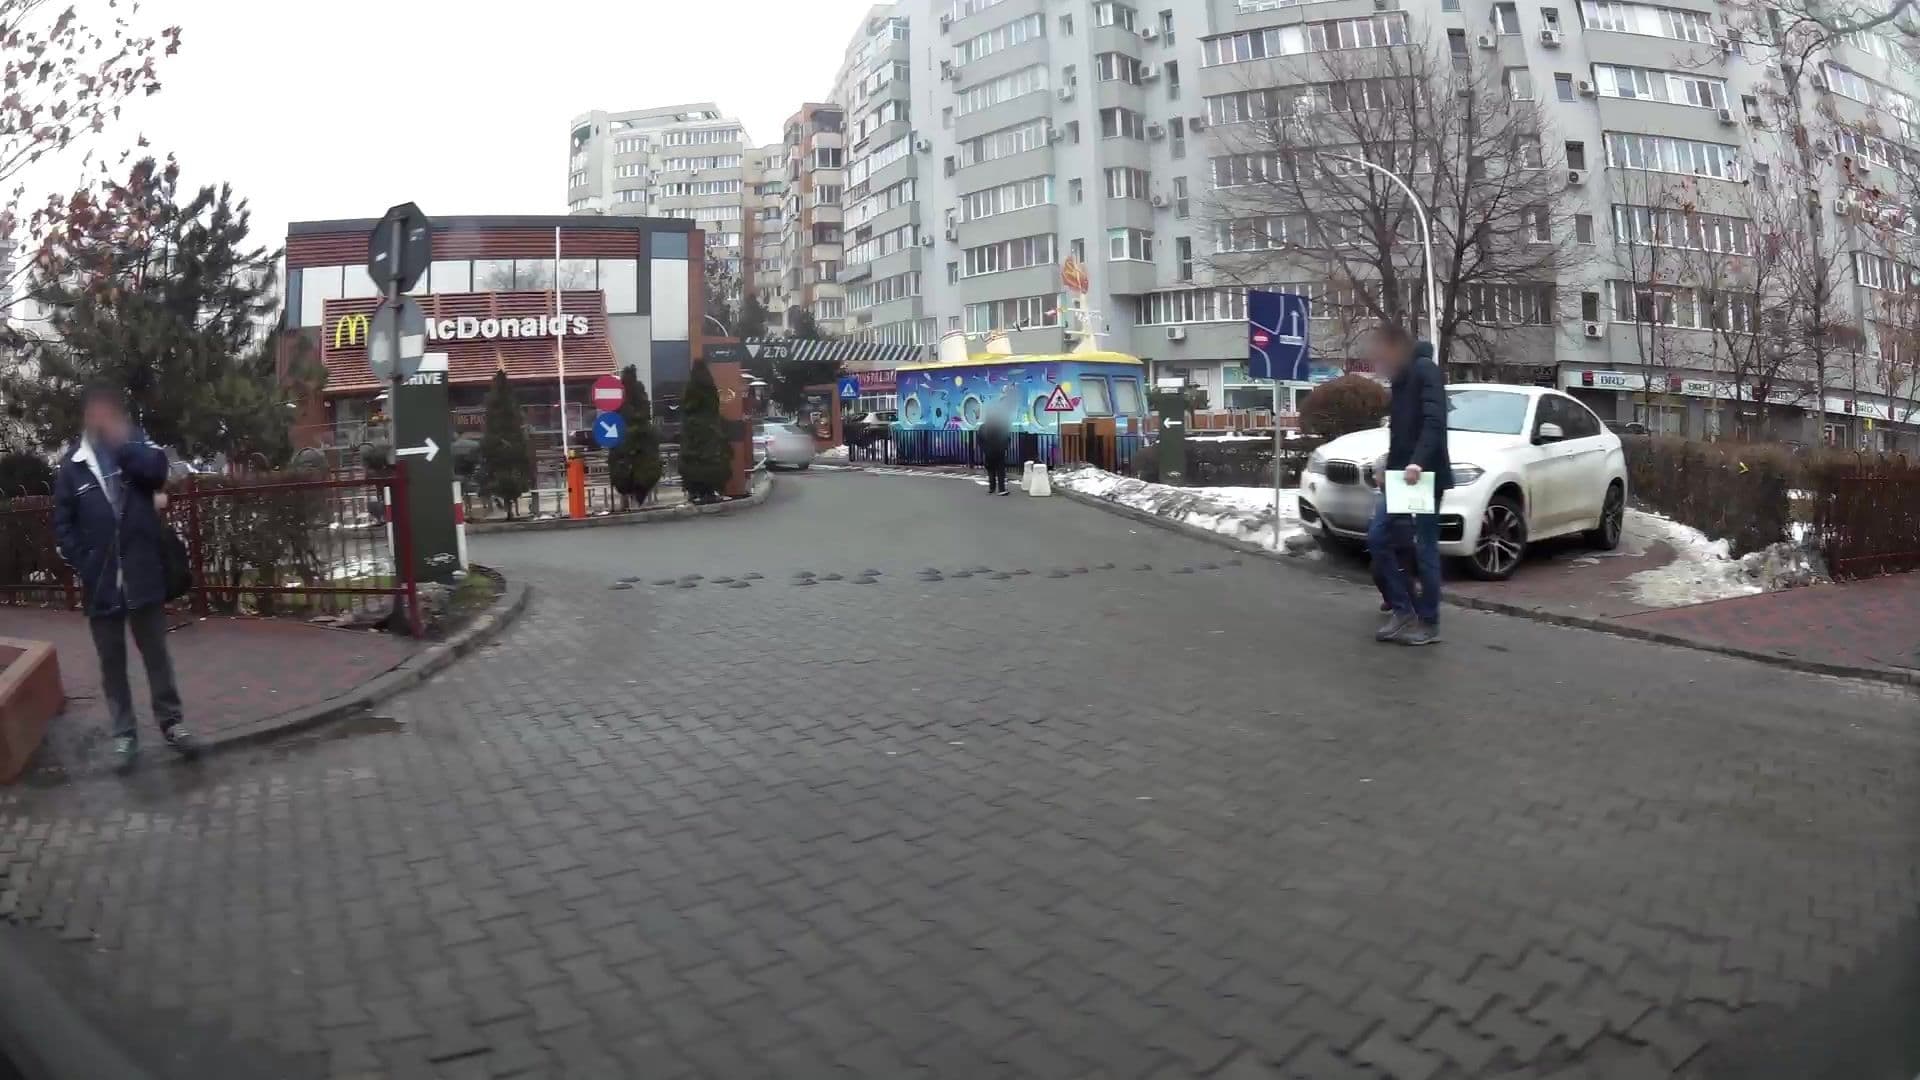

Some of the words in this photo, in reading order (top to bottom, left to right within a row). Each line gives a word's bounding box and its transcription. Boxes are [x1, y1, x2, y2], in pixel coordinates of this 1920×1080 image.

[763, 346, 788, 359] 2.70
[402, 372, 443, 385] RIVE
[1600, 375, 1625, 385] BRD
